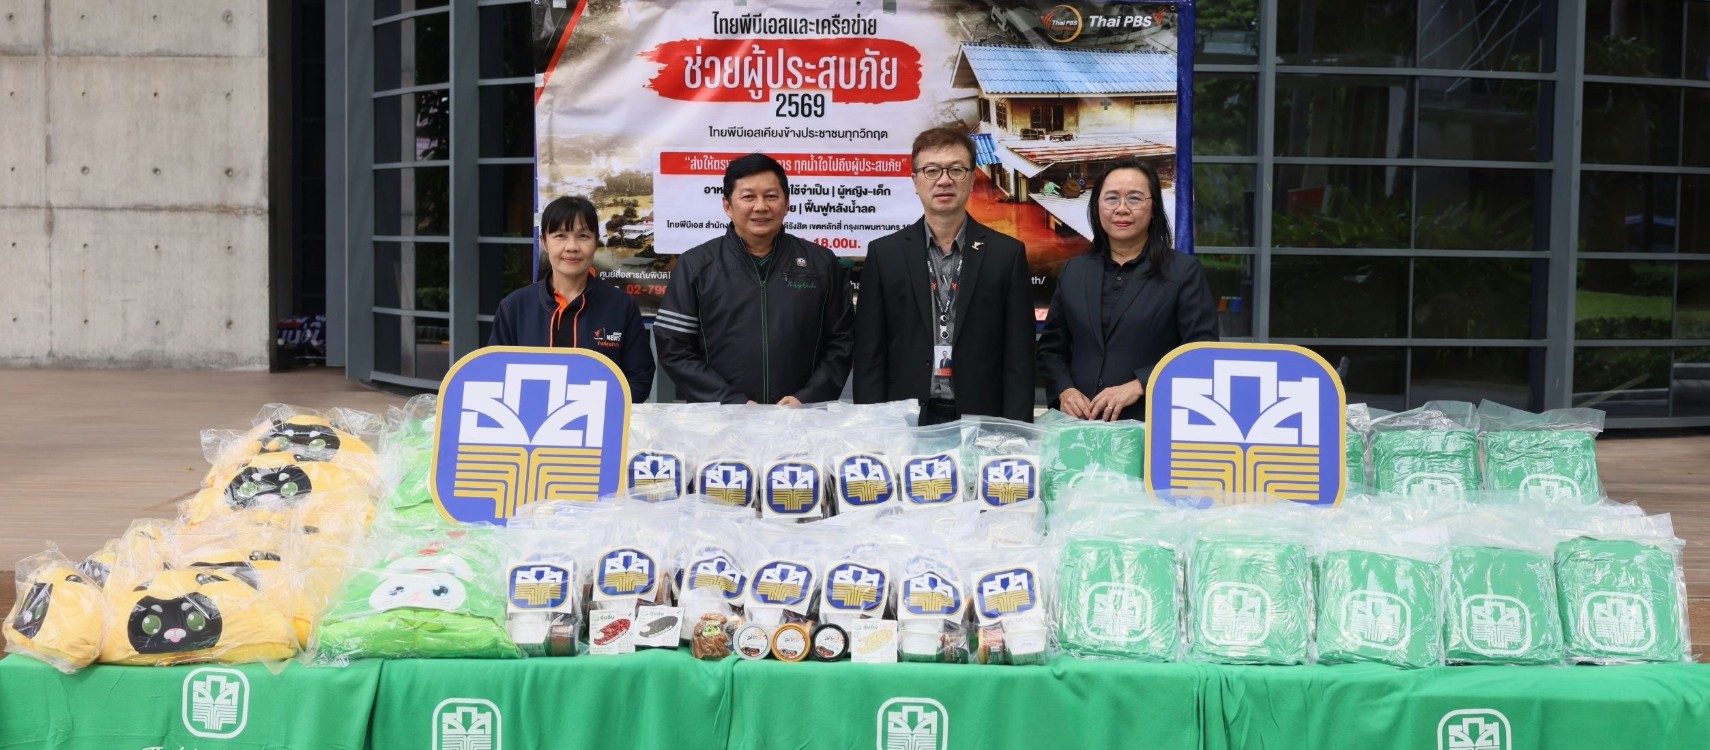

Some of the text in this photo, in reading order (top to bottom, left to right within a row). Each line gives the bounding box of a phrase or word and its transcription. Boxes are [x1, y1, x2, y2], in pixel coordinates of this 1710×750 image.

[712, 11, 878, 36] ไทยพีบีเอสและเครือข่าย
[1089, 15, 1153, 28] Thai PBS
[684, 44, 898, 101] ช่วยผู้ประสบภัย
[775, 93, 826, 118] 2569
[708, 126, 888, 142] ไทยพีบีเอสเคียงข้างประชาชนทุกวิกฤต
[804, 199, 876, 216] ฟื้นฟูหลังน้ำลด
[666, 219, 704, 229] ไทยพีบีเอส
[809, 220, 842, 230] เขตหลักสี่
[844, 223, 900, 233] กรุงเทพมหานคร
